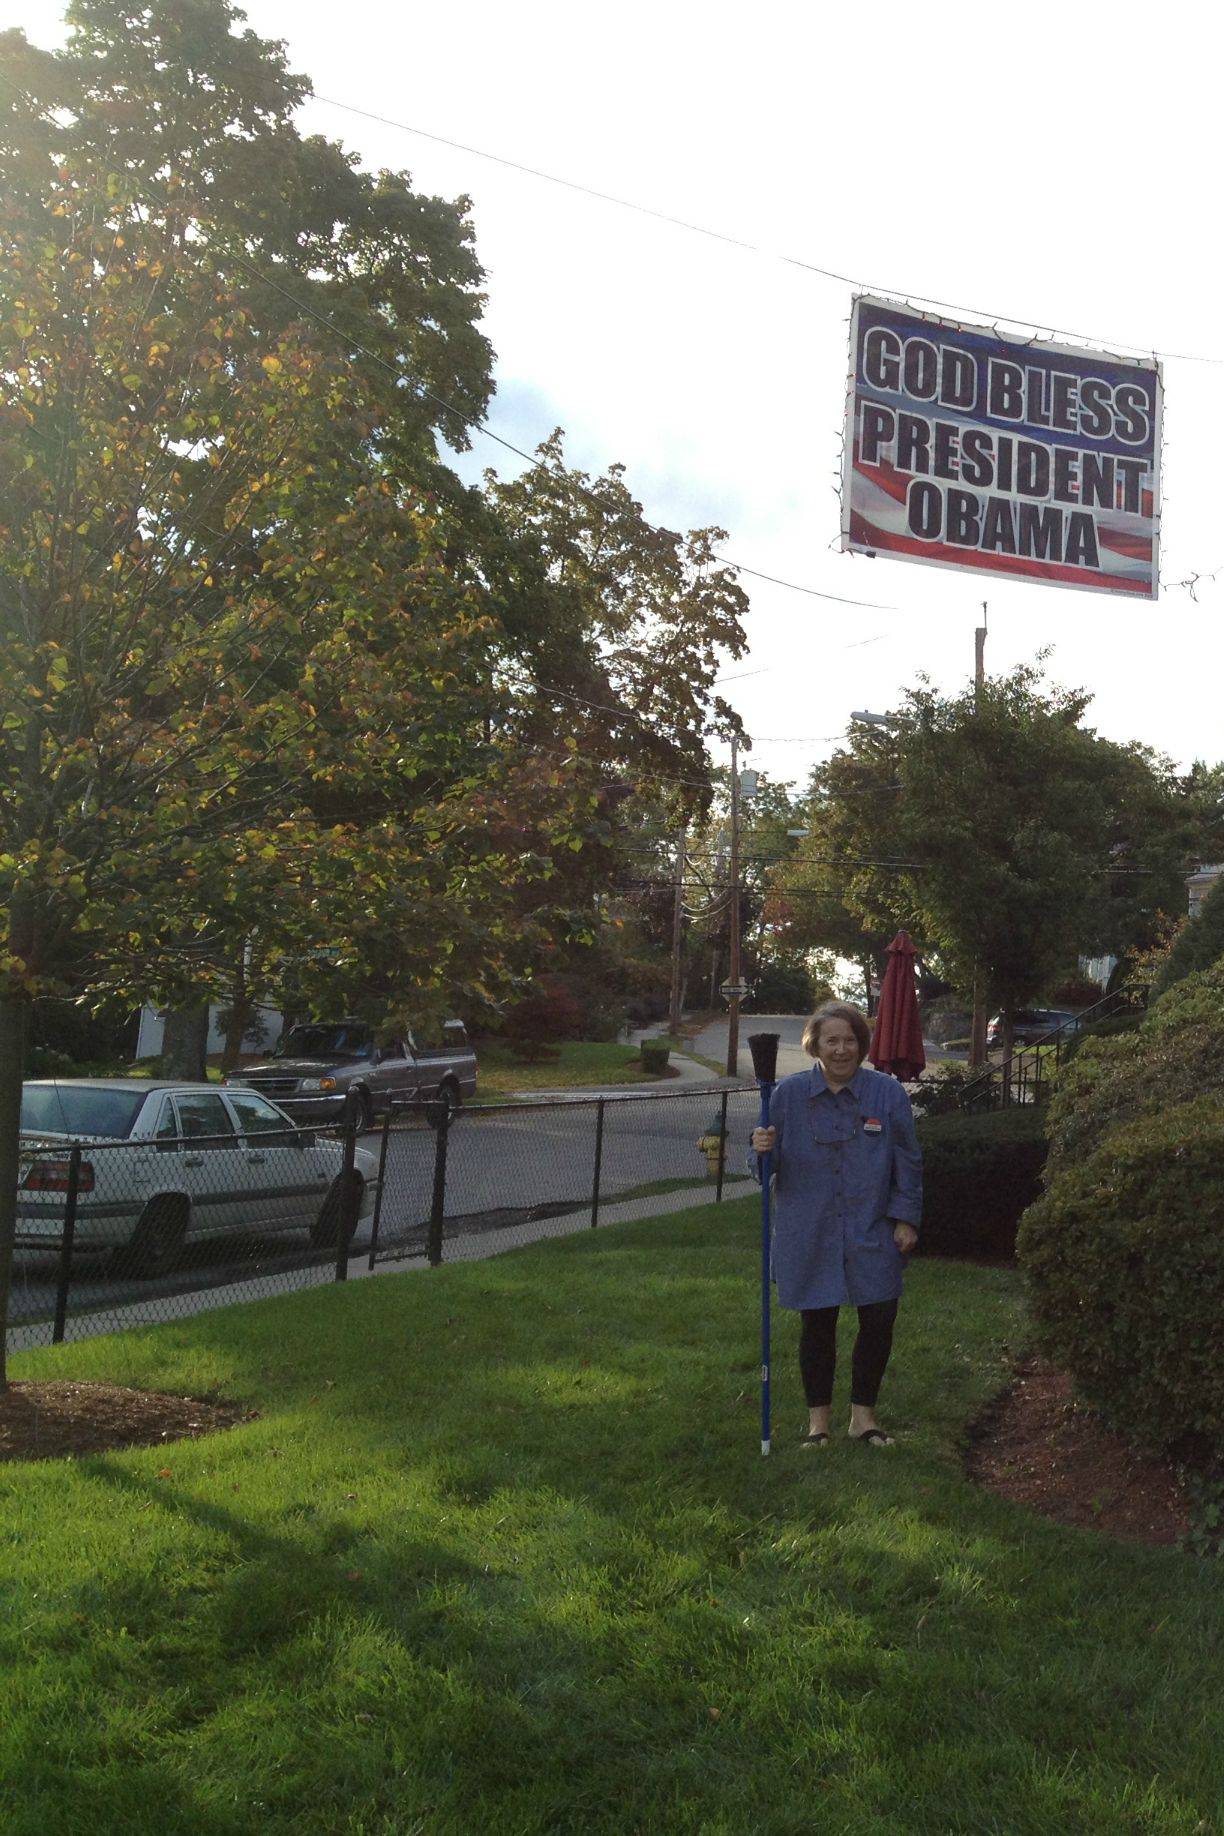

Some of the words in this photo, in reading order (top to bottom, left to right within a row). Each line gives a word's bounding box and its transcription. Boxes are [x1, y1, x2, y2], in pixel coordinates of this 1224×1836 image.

[863, 327, 978, 412] GOD
[987, 357, 1150, 446] BLESS
[859, 401, 1152, 515] PRESIDENT
[906, 479, 1100, 568] OBAMA
